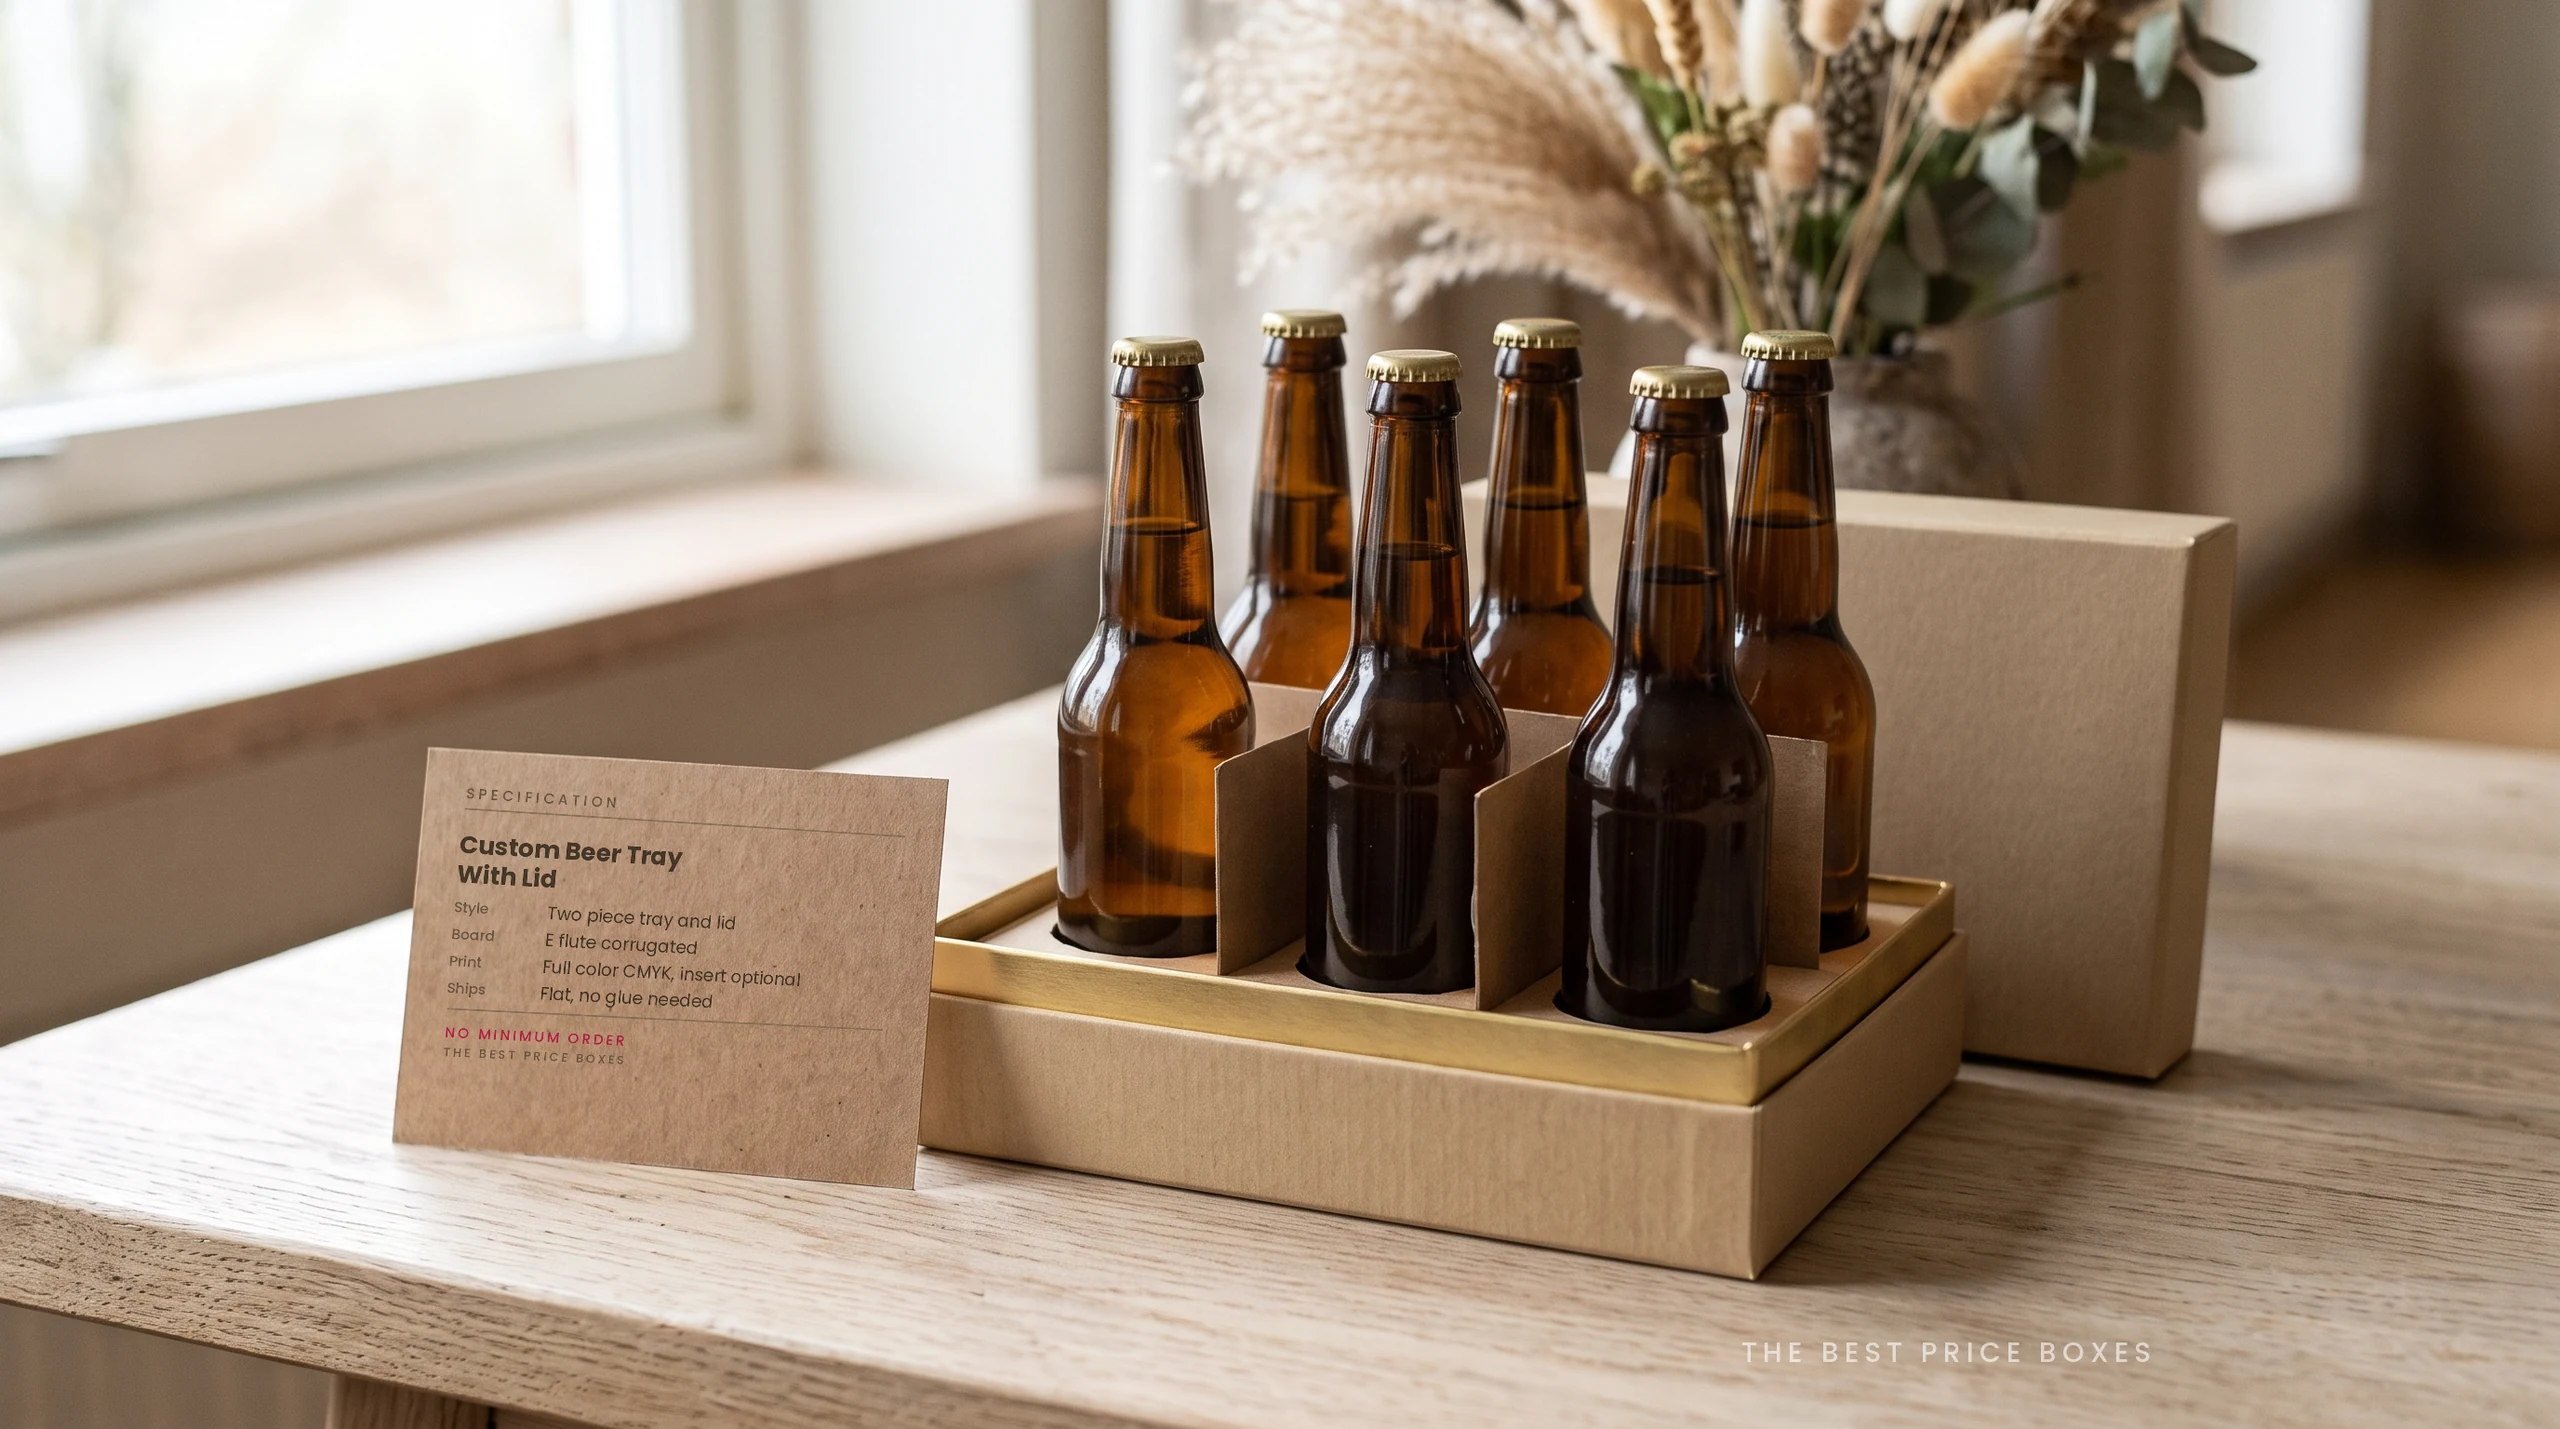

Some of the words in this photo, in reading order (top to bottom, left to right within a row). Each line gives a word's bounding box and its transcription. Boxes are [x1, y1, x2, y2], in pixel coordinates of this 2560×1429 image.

[466, 787, 617, 809] SPECIFICATION
[459, 835, 560, 860] Custom
[565, 841, 623, 863] Beer
[627, 845, 684, 873] Tray
[457, 863, 517, 887] With
[521, 866, 557, 889] Lid
[454, 901, 489, 917] Style
[547, 905, 582, 922] Two
[587, 909, 635, 928] piece
[639, 911, 674, 931] tray
[677, 914, 712, 930] and
[716, 914, 736, 931] lid
[451, 927, 495, 942] Board
[545, 932, 555, 947] E
[558, 933, 597, 950] flute
[601, 938, 698, 957] corrugated
[449, 954, 482, 969] Print
[542, 959, 571, 975] Full
[575, 962, 620, 978] color
[622, 964, 675, 983] CMYK,
[680, 968, 728, 984] insert
[730, 970, 801, 989] optional
[447, 981, 486, 998] Ships
[540, 986, 574, 1005] Flat,
[579, 991, 601, 1003] no
[605, 989, 644, 1009] glue
[647, 992, 713, 1009] needed
[444, 1026, 470, 1040] NO
[477, 1027, 561, 1044] MINIMUM
[567, 1032, 625, 1047] ORDER
[443, 1047, 471, 1058] THE
[478, 1048, 516, 1060] BEST
[523, 1050, 569, 1063] PRICE
[576, 1053, 624, 1065] BOXES
